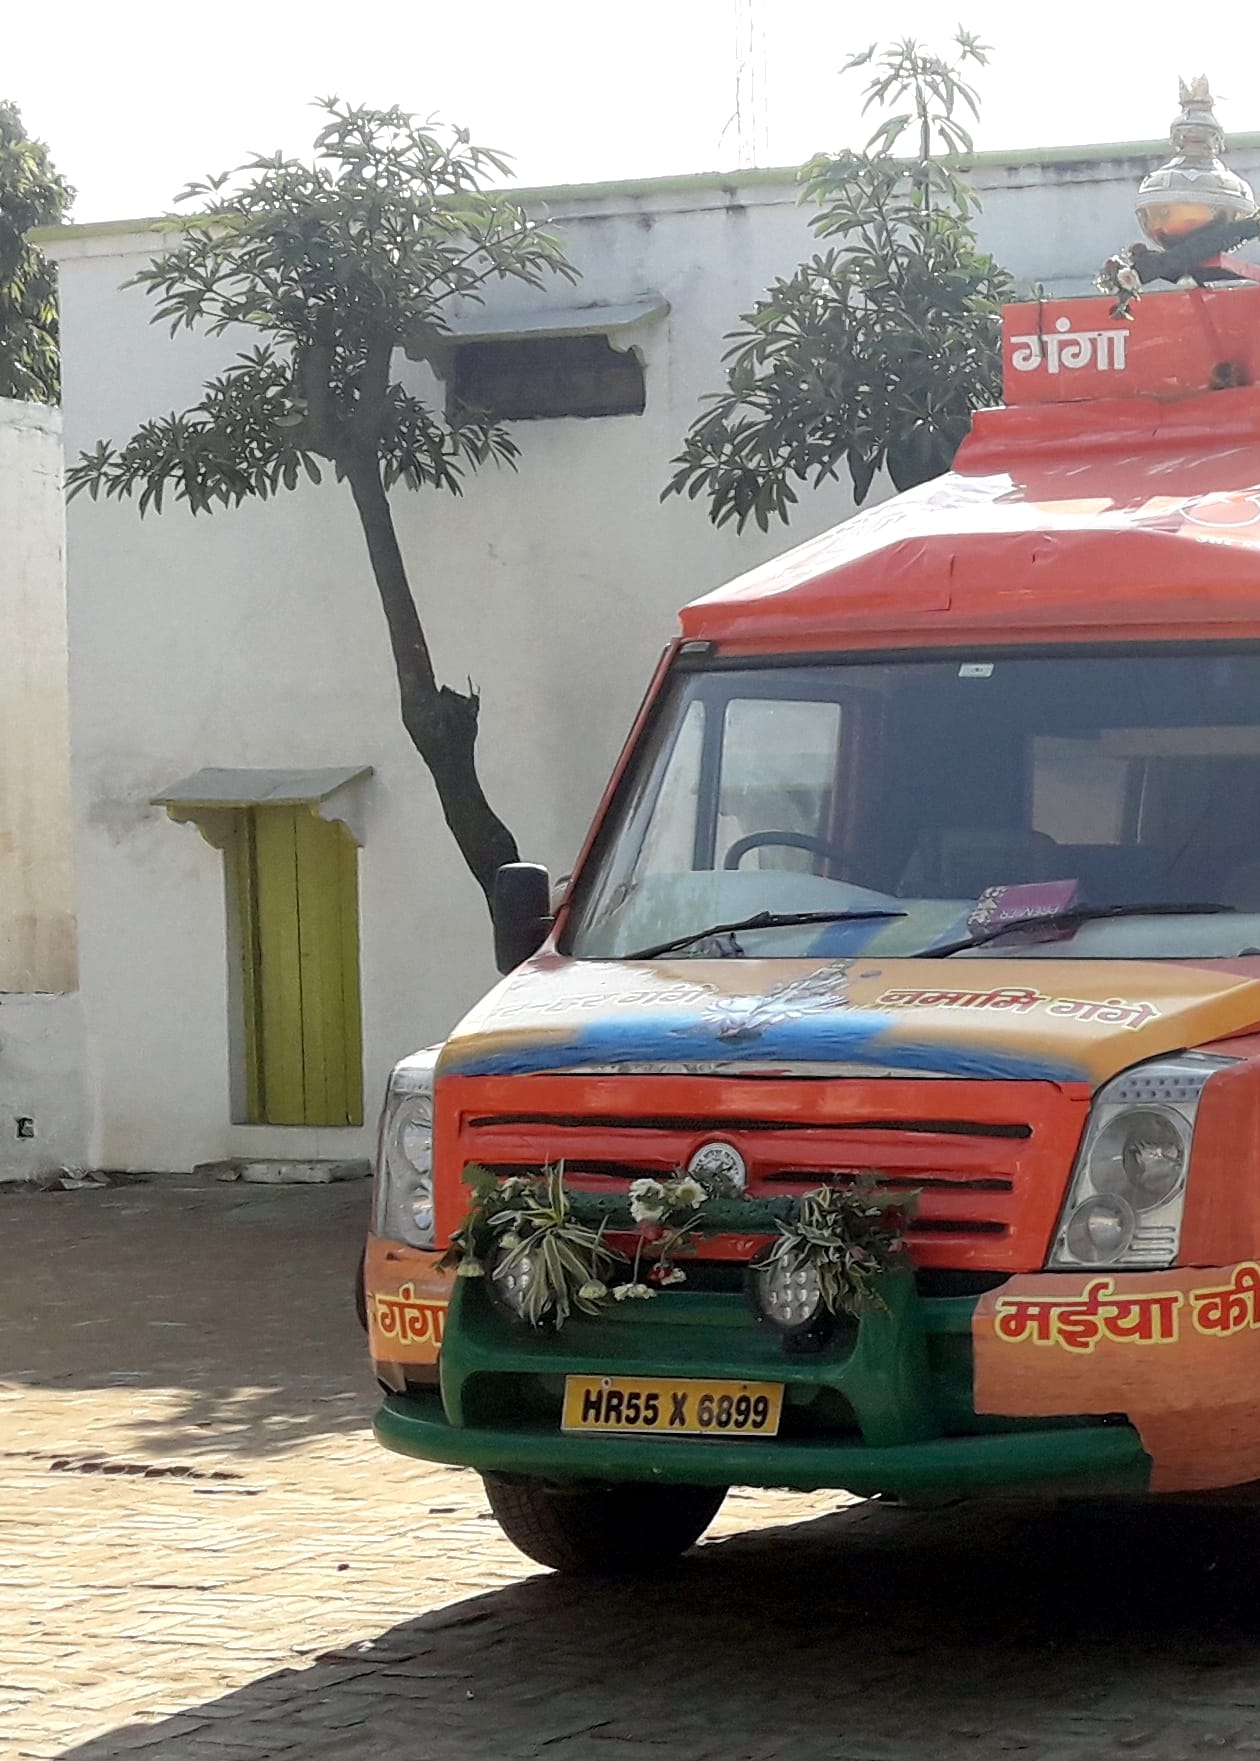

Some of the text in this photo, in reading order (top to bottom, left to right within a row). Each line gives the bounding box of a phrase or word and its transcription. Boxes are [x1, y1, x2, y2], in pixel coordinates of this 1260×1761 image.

[1010, 316, 1131, 374] गंगा
[876, 987, 1162, 1031] नमामि गंगे
[995, 1276, 1184, 1354] मईया
[580, 1388, 770, 1430] HR55 X 6899
